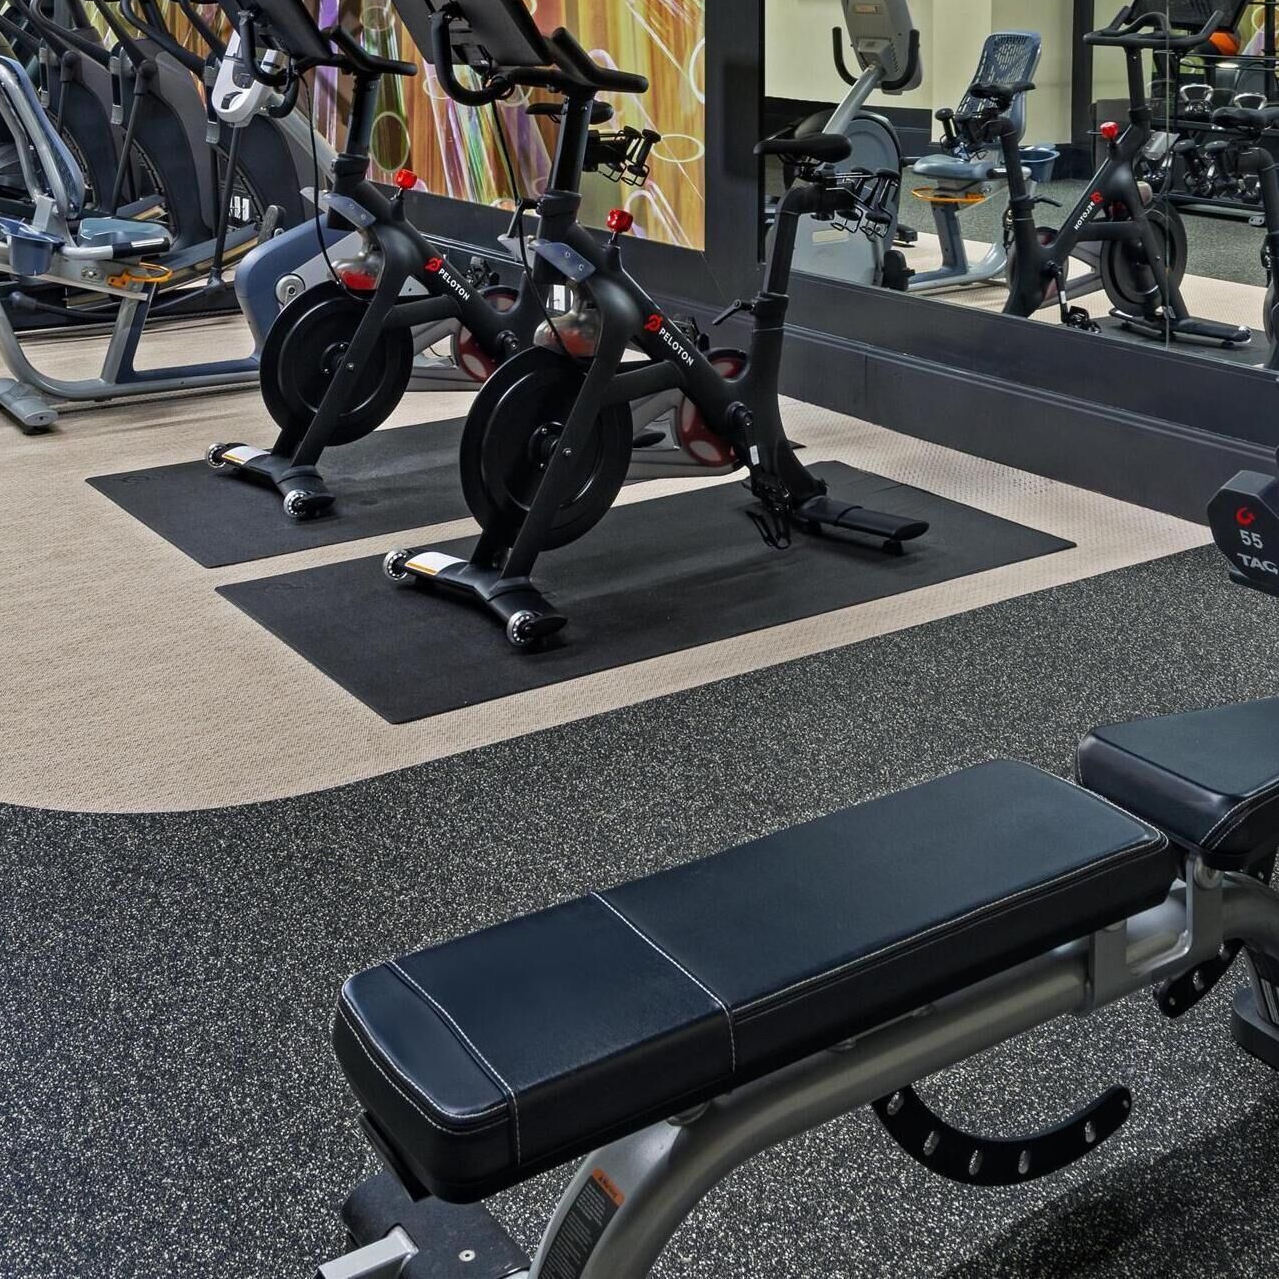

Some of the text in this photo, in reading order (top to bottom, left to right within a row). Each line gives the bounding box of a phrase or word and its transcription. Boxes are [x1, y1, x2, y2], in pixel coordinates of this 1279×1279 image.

[438, 267, 470, 301] PELOTON
[658, 326, 695, 367] PELOTON
[1239, 529, 1264, 549] 55
[1235, 552, 1279, 576] TAG
